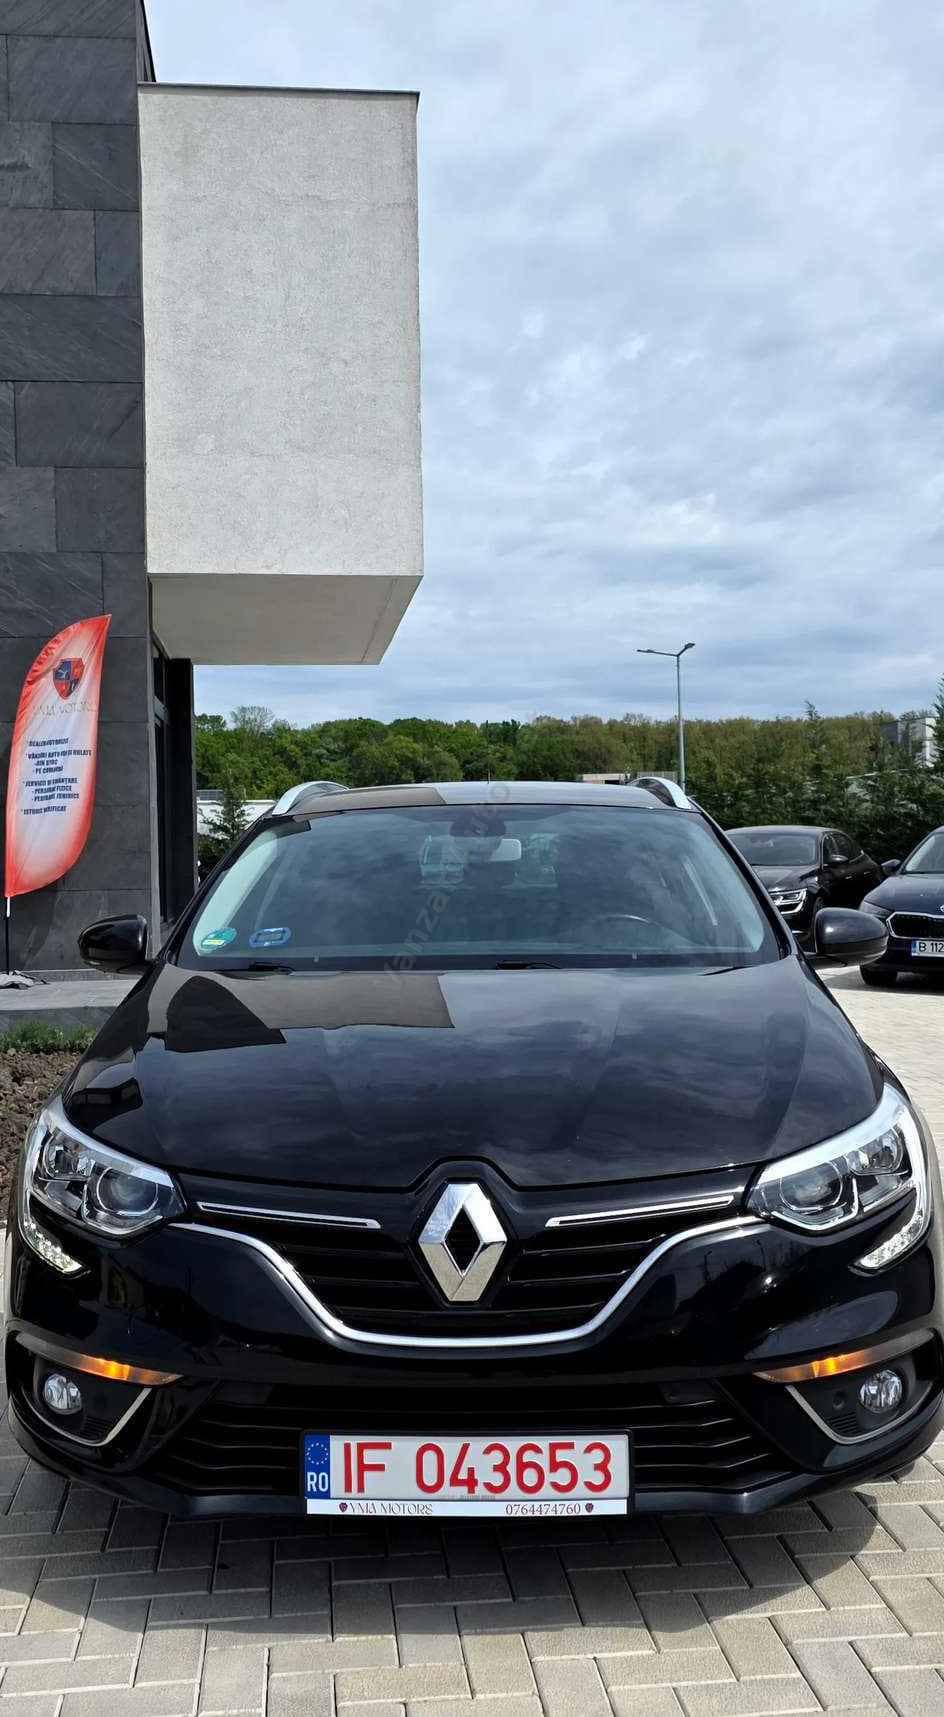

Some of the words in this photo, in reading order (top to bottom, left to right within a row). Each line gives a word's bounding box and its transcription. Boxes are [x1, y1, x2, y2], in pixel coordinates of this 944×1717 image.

[918, 942, 927, 952] B
[344, 1441, 392, 1494] IF
[415, 1441, 612, 1495] 043653
[307, 1471, 329, 1492] RO
[350, 1502, 378, 1514] YMA
[380, 1502, 433, 1515] MOTORS
[505, 1502, 581, 1515] 0764474760
